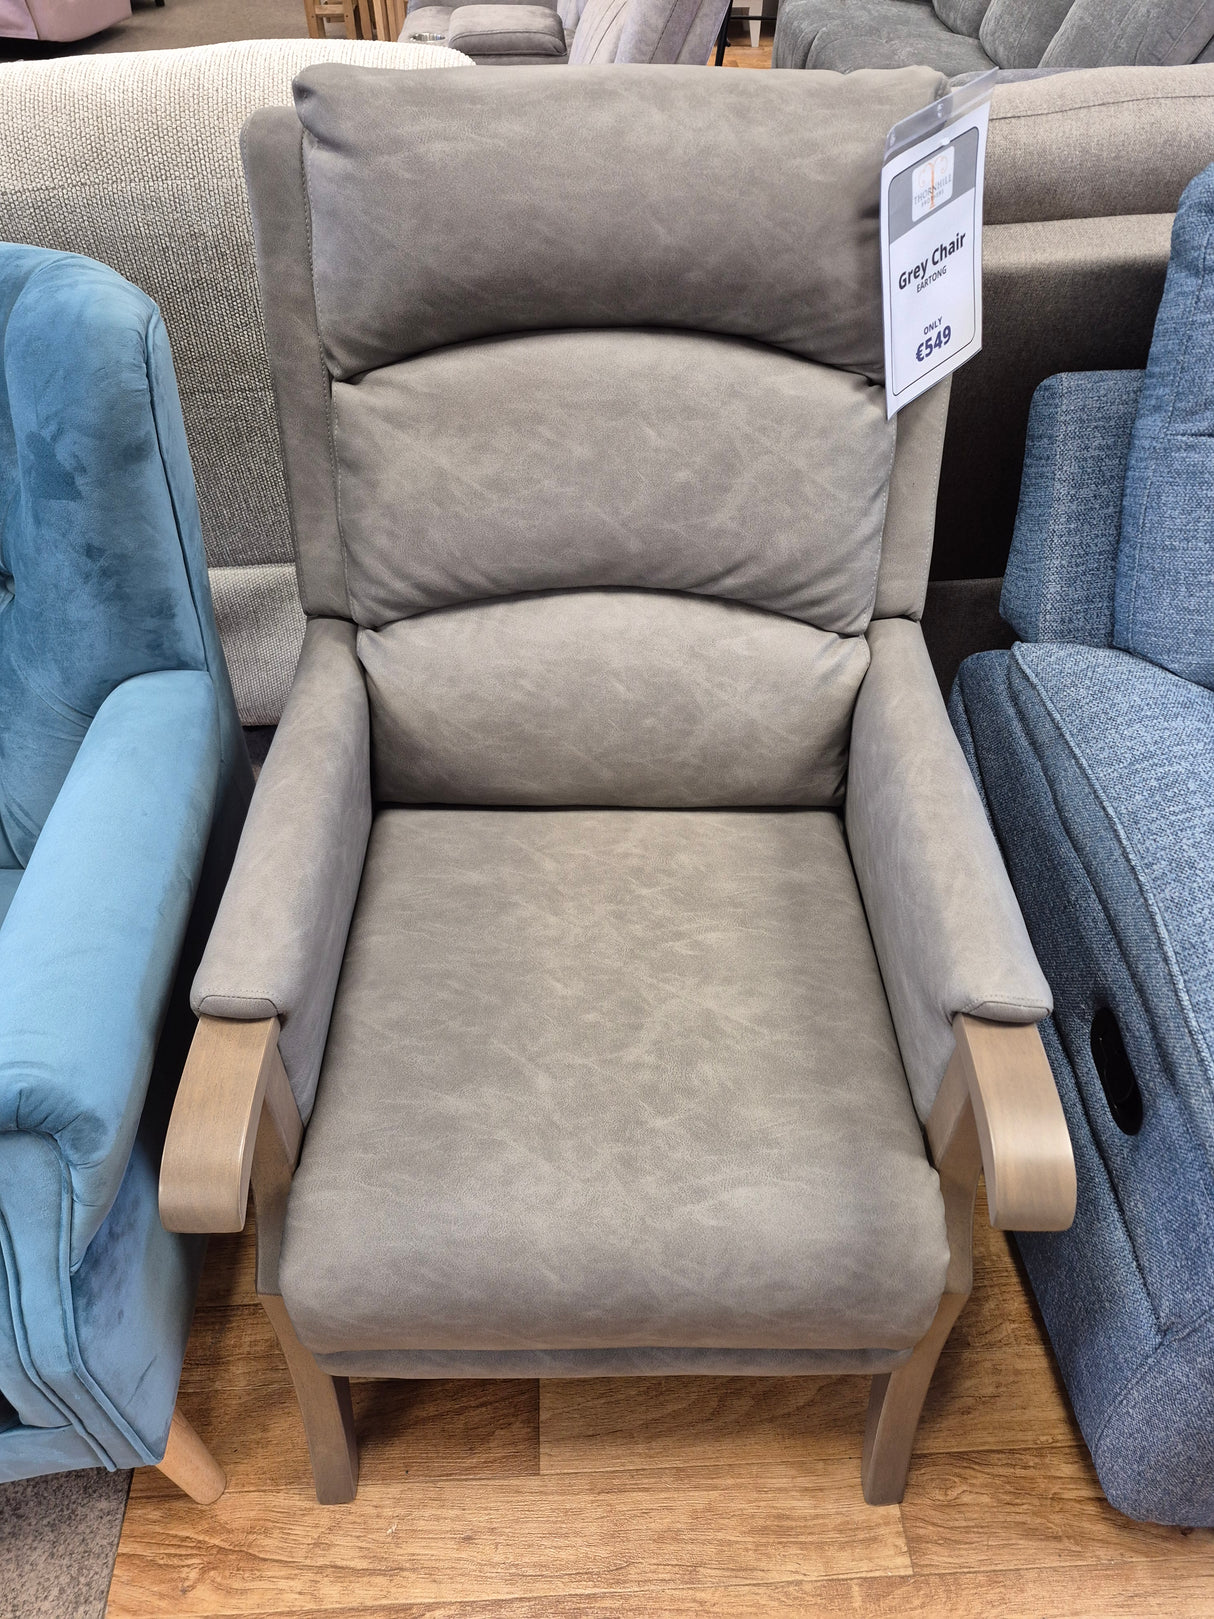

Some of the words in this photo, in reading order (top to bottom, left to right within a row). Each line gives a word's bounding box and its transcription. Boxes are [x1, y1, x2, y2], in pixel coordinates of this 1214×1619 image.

[899, 258, 929, 290] Grey
[931, 232, 966, 266] Chair
[916, 265, 947, 293] EARTONG
[923, 316, 943, 335] ONLY
[916, 325, 951, 362] €549
